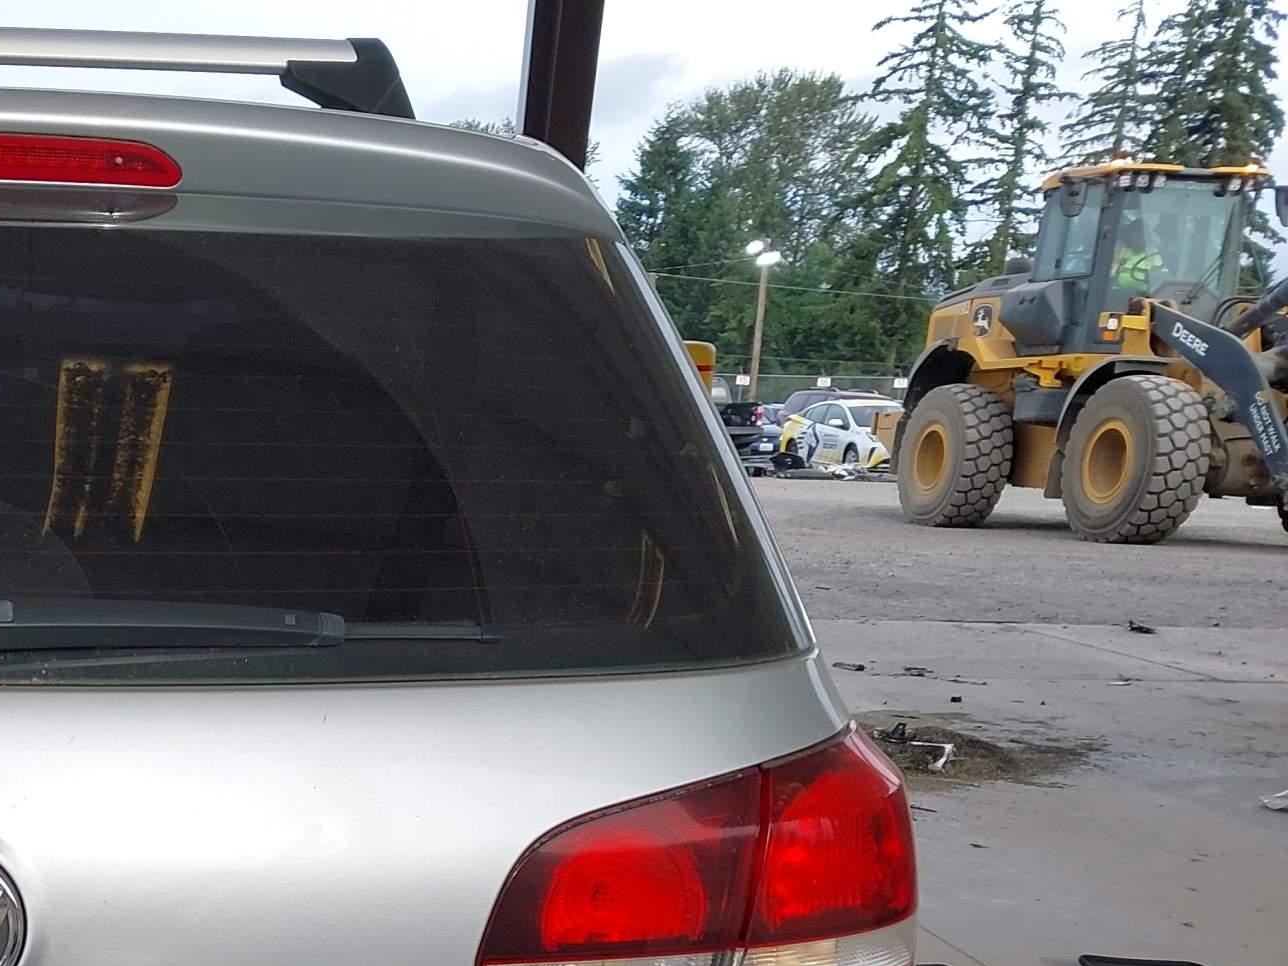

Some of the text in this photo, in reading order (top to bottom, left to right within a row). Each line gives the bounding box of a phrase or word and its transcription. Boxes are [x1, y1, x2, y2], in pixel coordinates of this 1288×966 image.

[1172, 321, 1210, 357] DEERE
[1260, 404, 1272, 425] NOT
[1268, 424, 1281, 453] WALK
